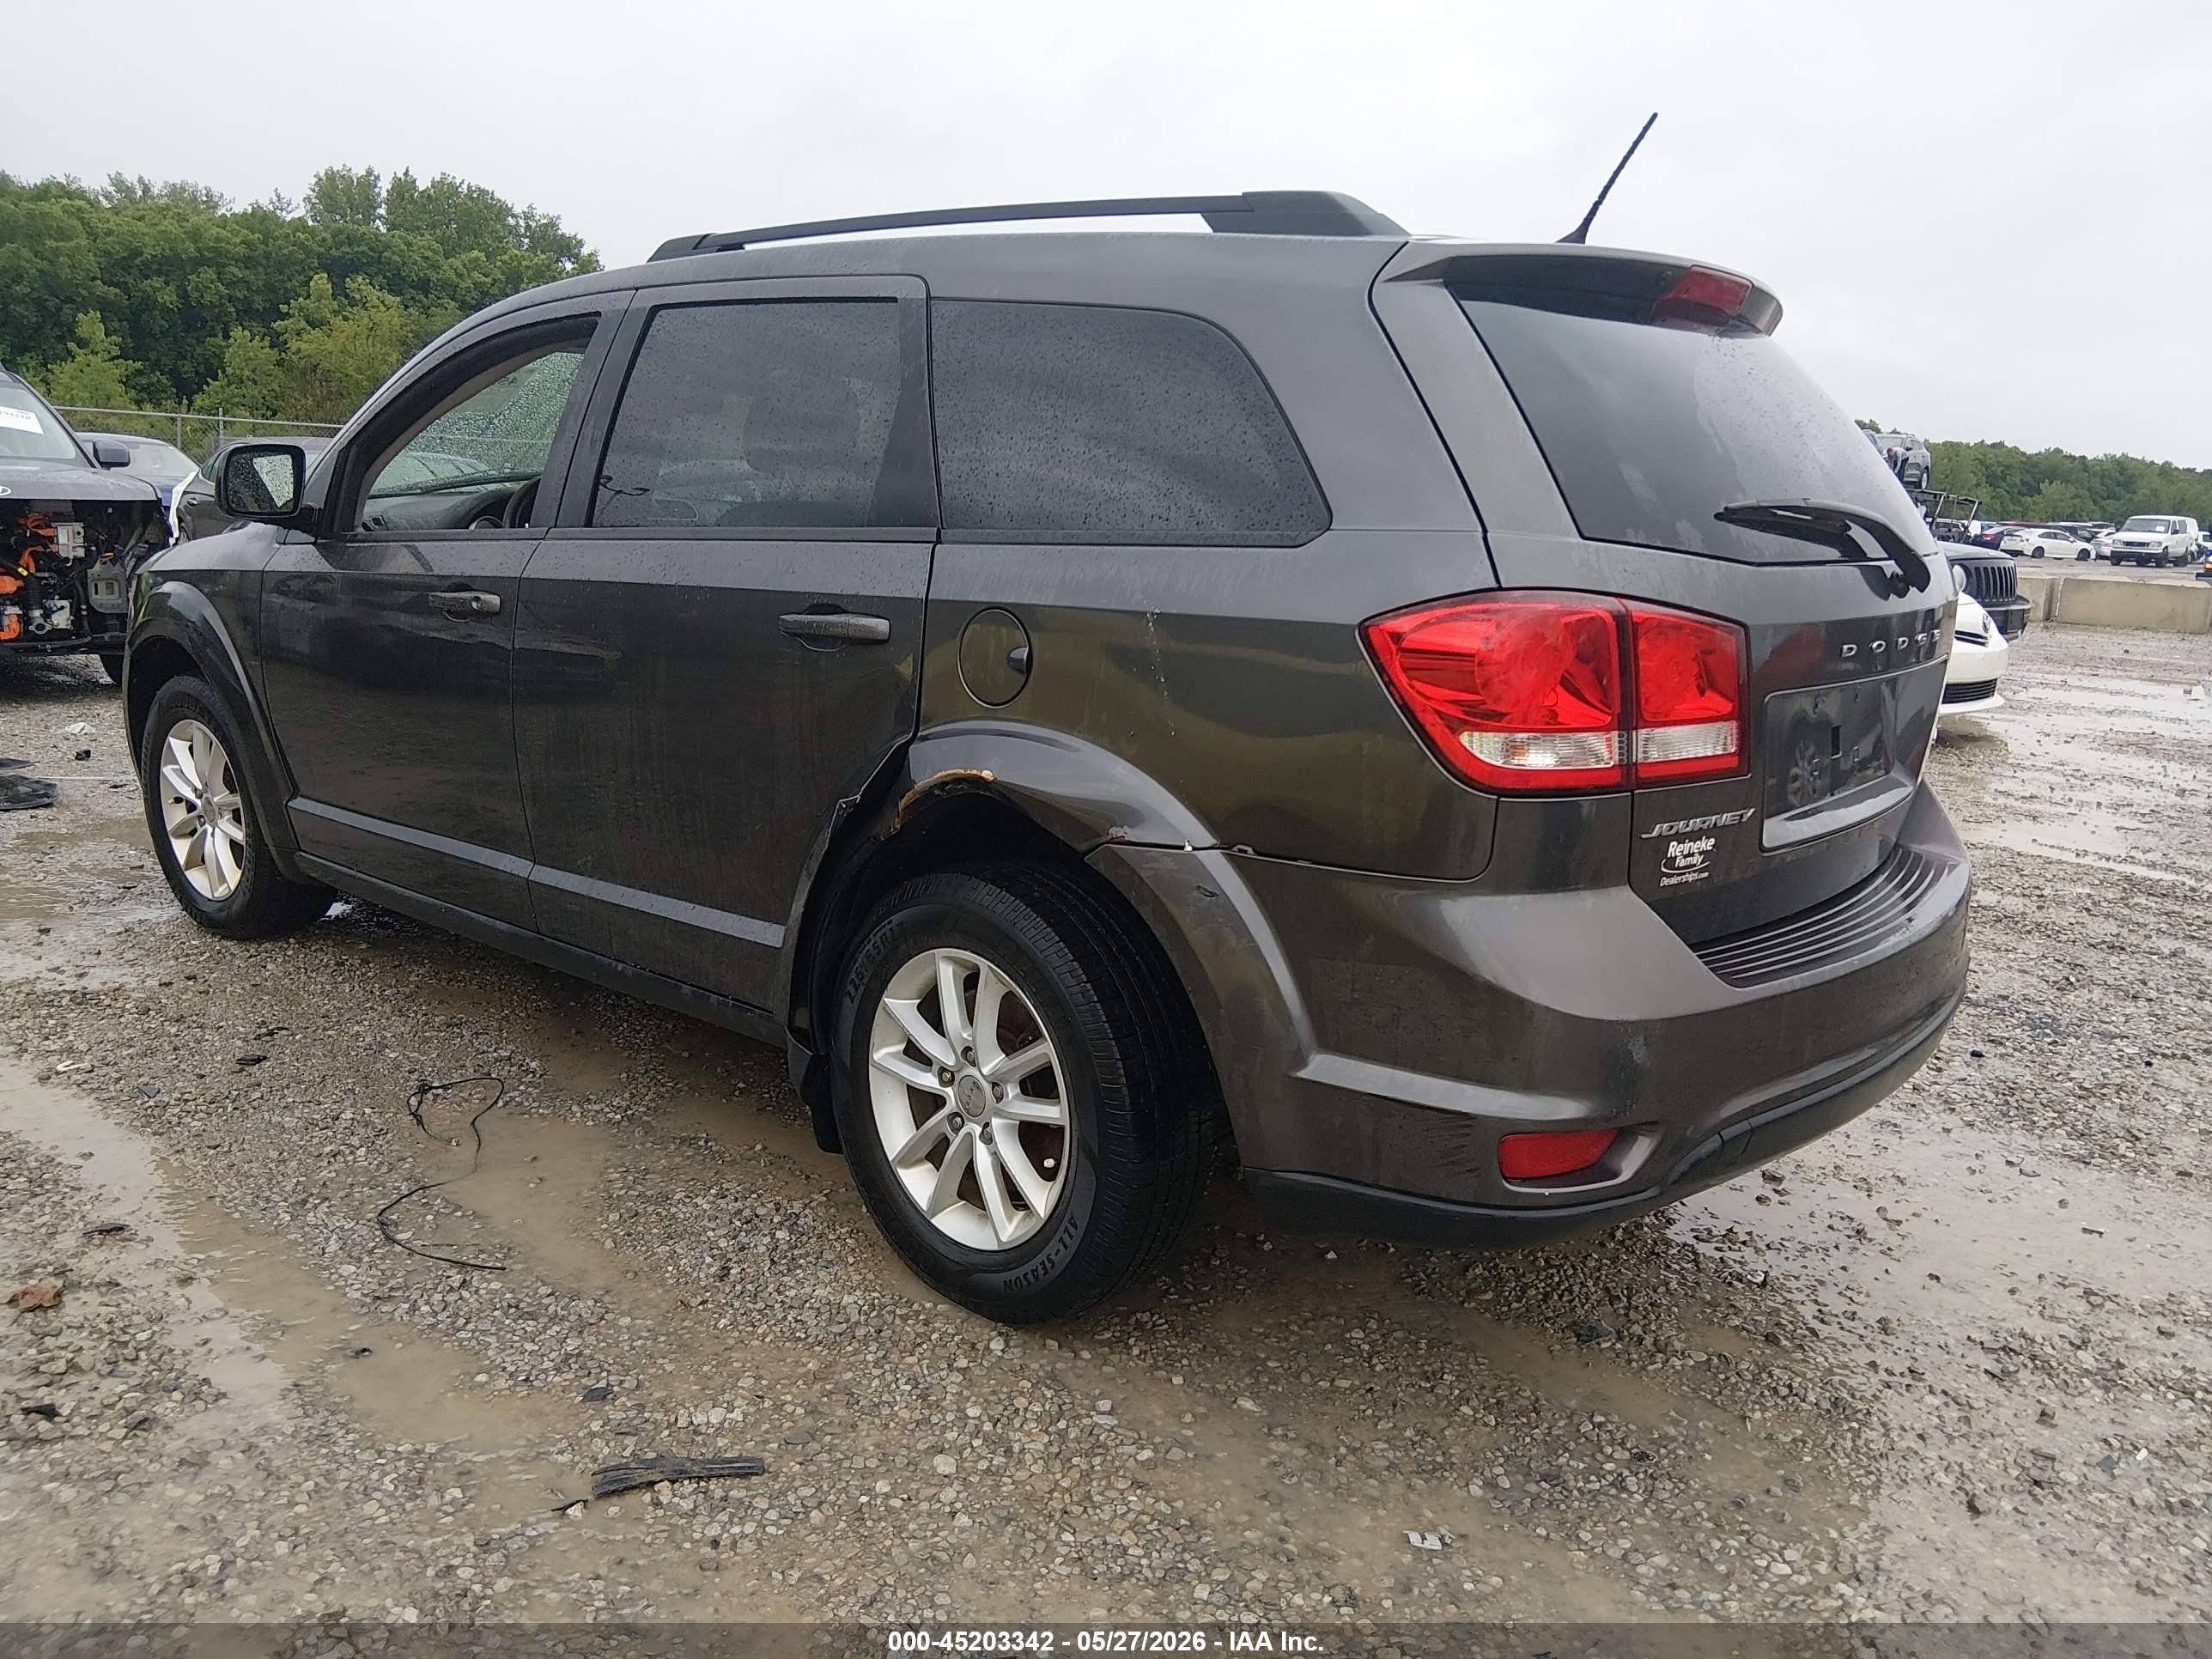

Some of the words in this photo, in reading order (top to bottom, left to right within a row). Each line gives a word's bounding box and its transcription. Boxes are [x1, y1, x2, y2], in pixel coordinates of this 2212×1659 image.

[1840, 629, 1941, 658] DODGE
[1641, 807, 1756, 838] JOURNEY
[1667, 836, 1716, 858] Reineke
[1674, 853, 1705, 868] Family
[1659, 872, 1710, 887] Dealerships.com
[1002, 1213, 1079, 1292] ALL-SEASON
